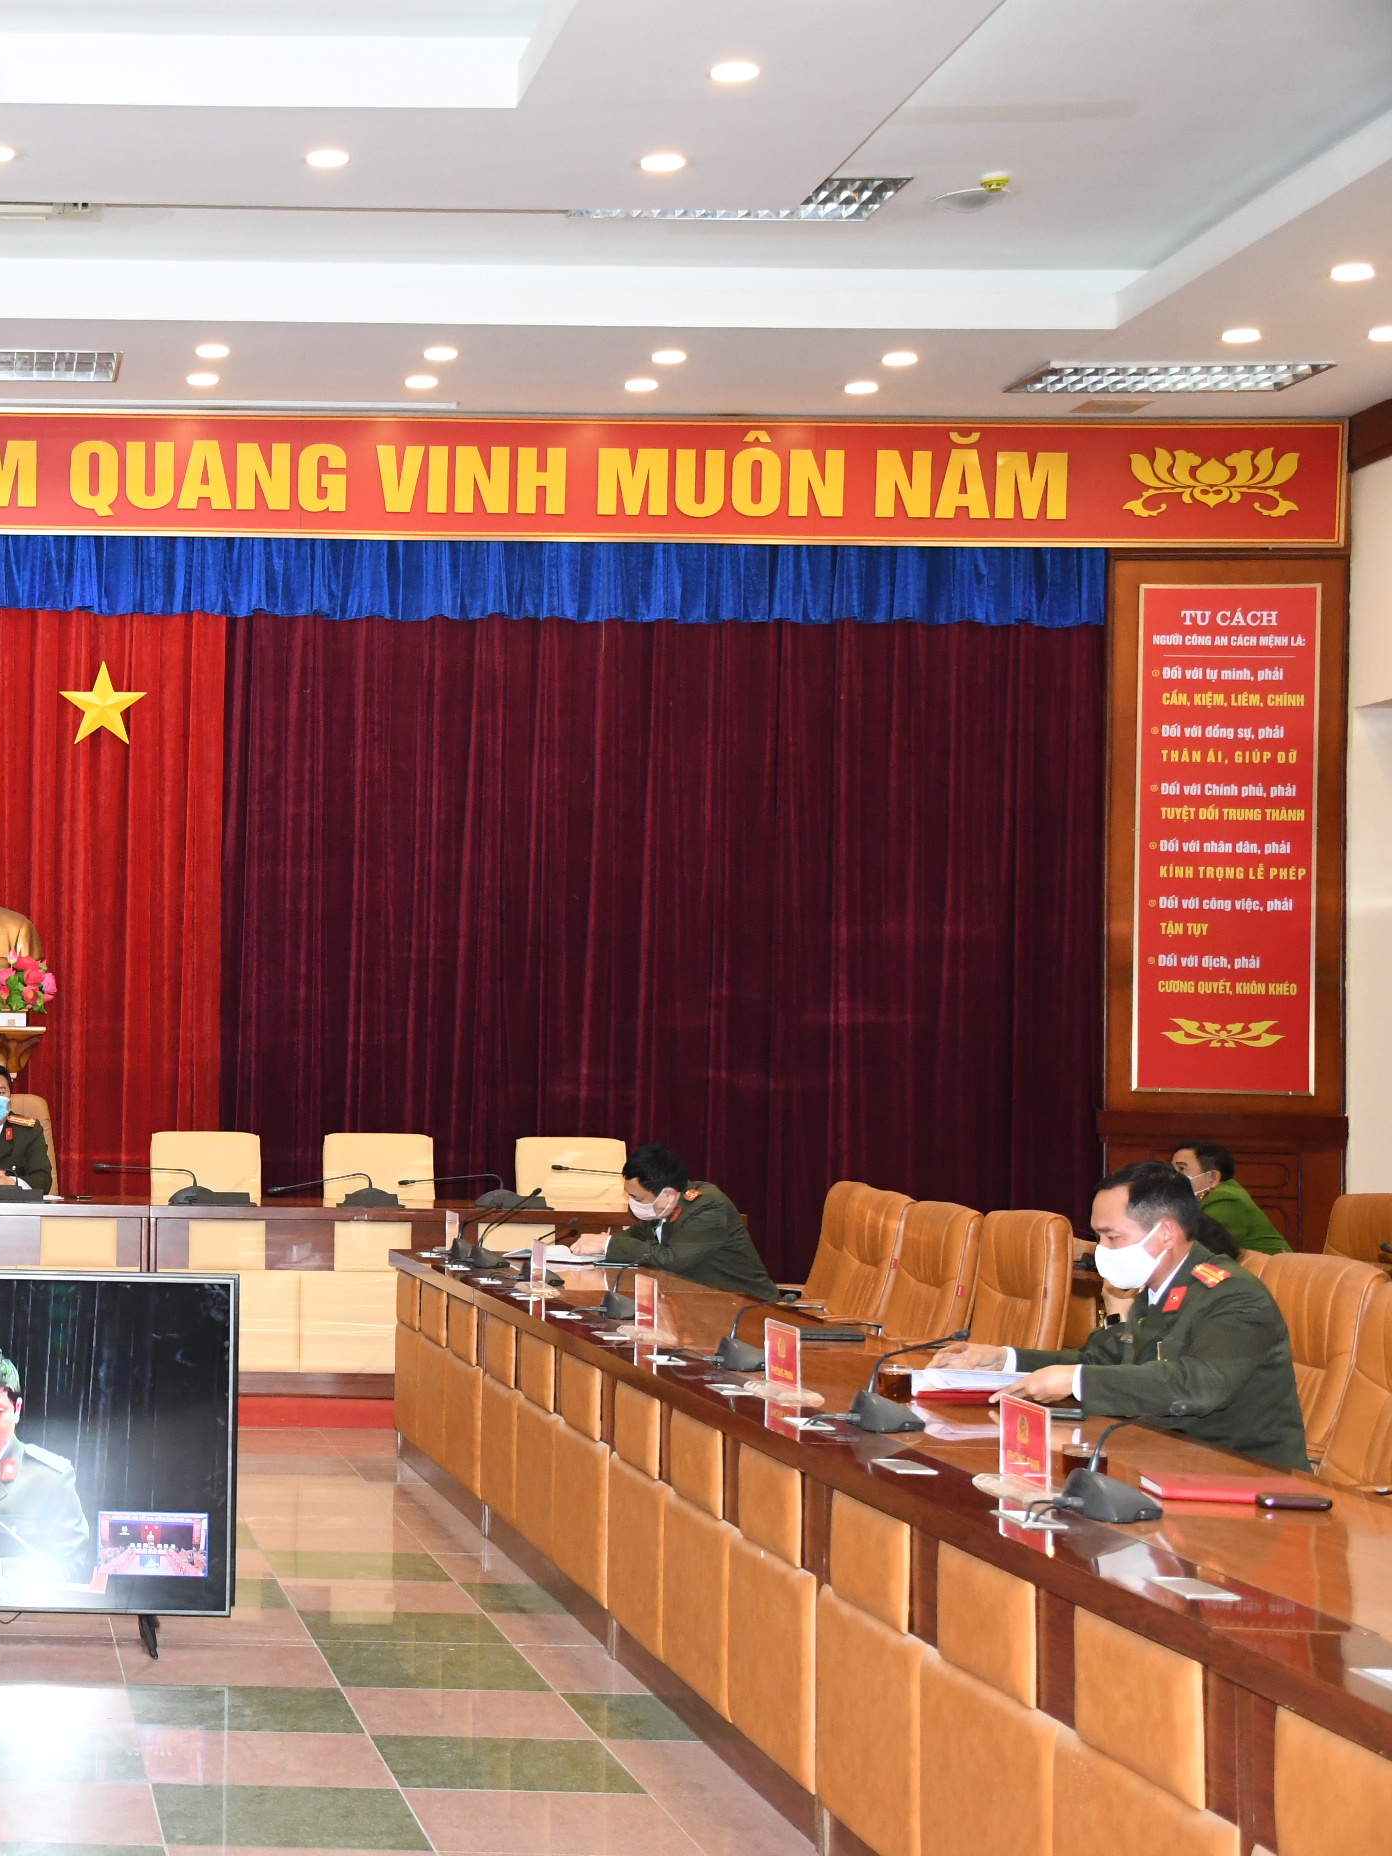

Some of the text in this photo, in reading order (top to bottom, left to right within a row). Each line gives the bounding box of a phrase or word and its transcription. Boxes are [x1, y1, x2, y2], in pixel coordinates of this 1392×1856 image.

[69, 439, 348, 518] QUANG
[375, 444, 567, 516] VINH
[596, 430, 846, 519] MUÔN
[874, 431, 1069, 520] NĂM
[1180, 607, 1278, 625] TƯ CÁCH
[1152, 633, 1182, 645] NGƯỜI
[1185, 633, 1211, 645] CÔNG
[1214, 636, 1228, 645] AN
[1230, 634, 1256, 645] CÁCH
[1259, 634, 1288, 648] MỆNH
[1162, 665, 1181, 679] Đối
[1184, 667, 1202, 679] với
[1205, 668, 1218, 682] tự
[1257, 666, 1283, 681] phải
[1267, 692, 1304, 706] CHÍNH
[1161, 723, 1180, 737] Đối
[1183, 725, 1201, 737] với
[1205, 724, 1234, 739] đồng
[1258, 724, 1284, 739] phải
[1161, 748, 1200, 762] THÂN
[1234, 749, 1271, 763] GIÚP
[1277, 749, 1296, 763] ĐỠ
[1160, 781, 1180, 794] Đối
[1183, 783, 1200, 795] với
[1204, 783, 1238, 795] Chính
[1270, 783, 1296, 797] phải
[1160, 804, 1304, 822] TUYỆT ĐỐI TRUNG THÀNH
[1159, 838, 1178, 851] Đối
[1182, 840, 1199, 852] với
[1203, 840, 1232, 852] nhân
[1264, 840, 1290, 854] phải
[1159, 863, 1305, 881] KÍNH TRỌNG LỄ PHÉP
[1159, 894, 1178, 908] Đối
[1181, 896, 1199, 908] với
[1202, 897, 1231, 911] công
[1266, 897, 1292, 911] phải
[1160, 920, 1208, 937] TẬN TỤY
[1157, 952, 1177, 966] Đối
[1180, 954, 1198, 967] với
[1234, 955, 1260, 969] phải
[1158, 979, 1194, 993] CƯƠNG
[1235, 980, 1265, 994] KHÔN
[1268, 981, 1297, 995] KHÉO
